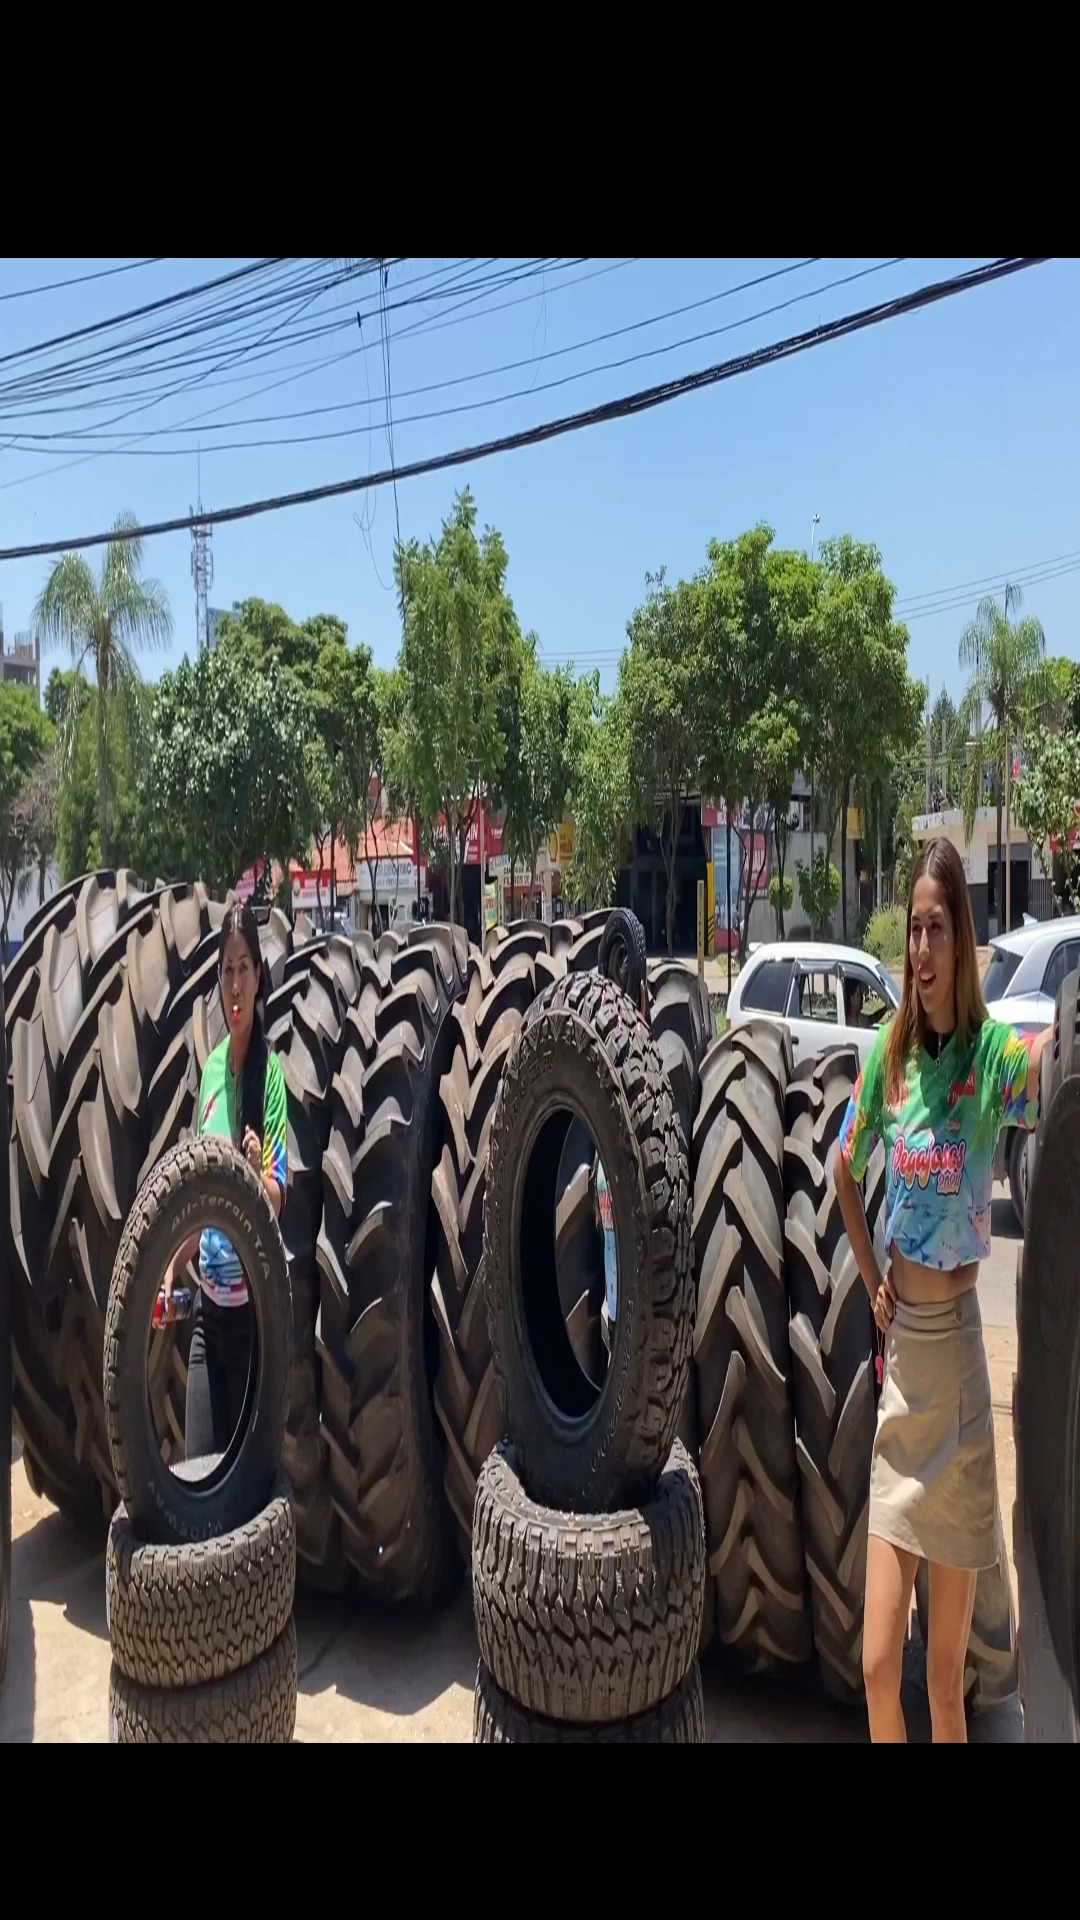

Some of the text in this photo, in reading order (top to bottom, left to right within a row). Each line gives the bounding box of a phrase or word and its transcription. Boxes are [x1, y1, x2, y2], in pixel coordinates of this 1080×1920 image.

[893, 1136, 965, 1188] Pegajosos
[938, 1173, 962, 1192] 2024
[172, 1194, 270, 1280] All-Terrain T/A
